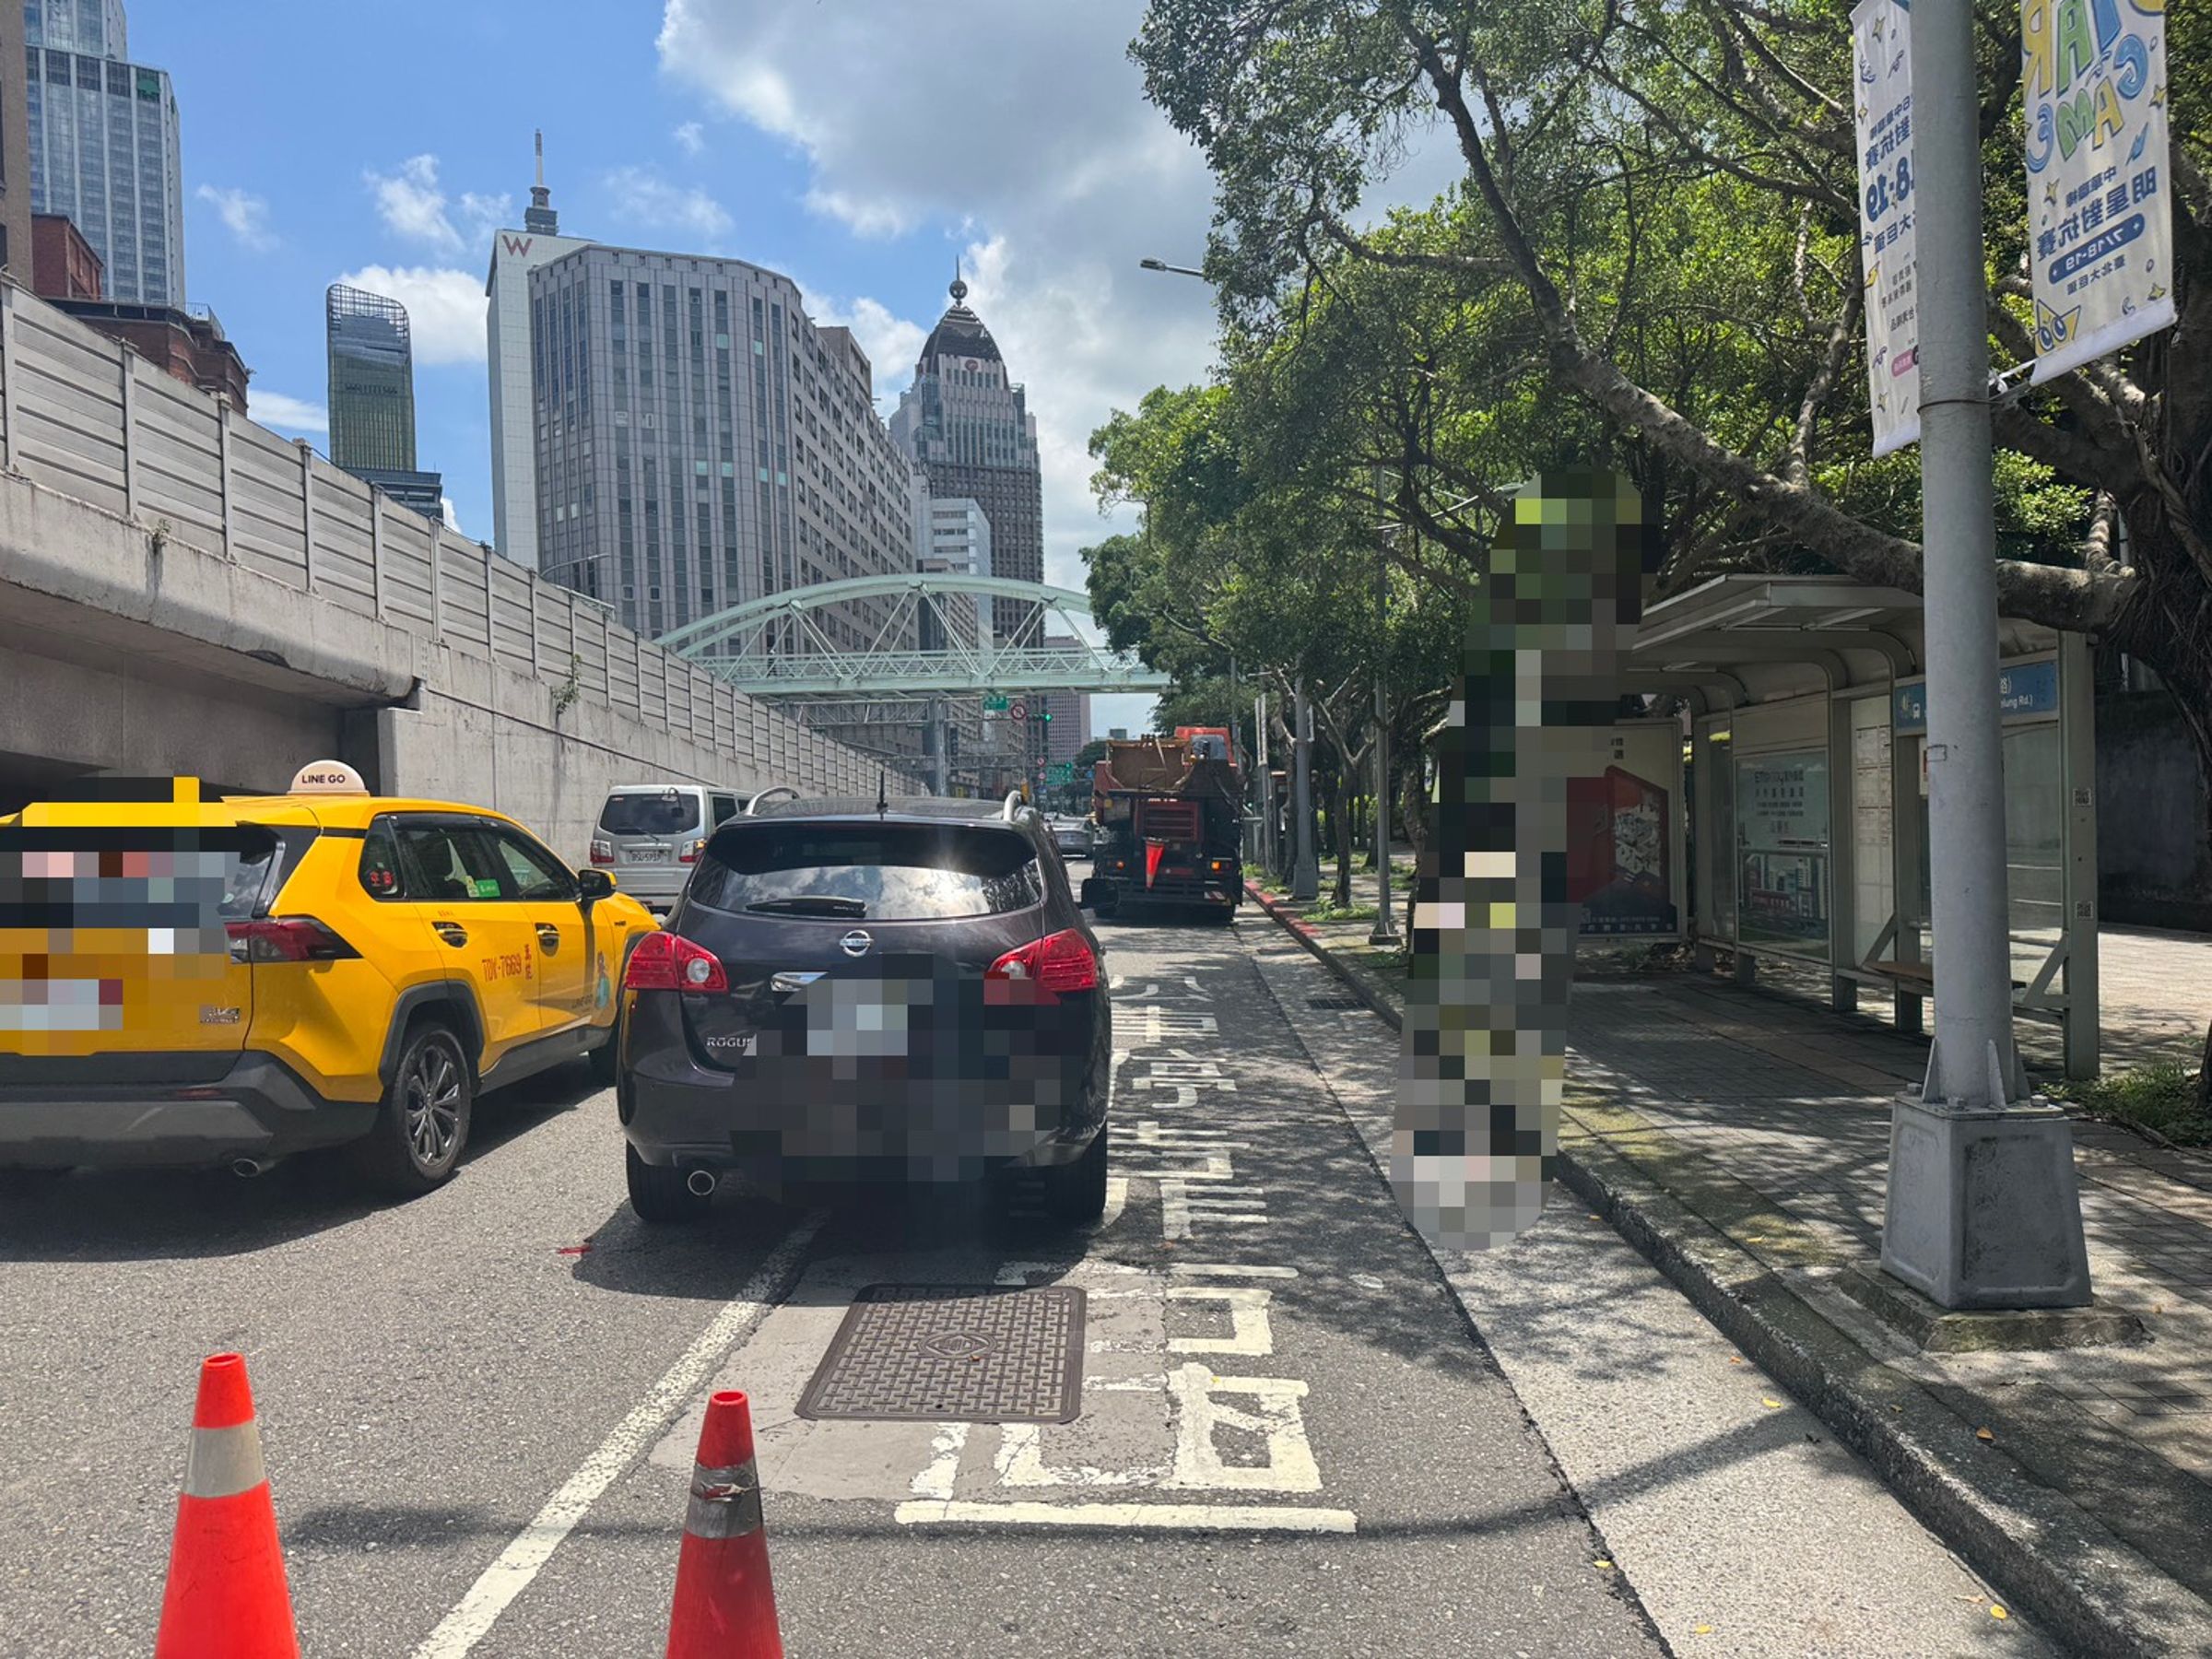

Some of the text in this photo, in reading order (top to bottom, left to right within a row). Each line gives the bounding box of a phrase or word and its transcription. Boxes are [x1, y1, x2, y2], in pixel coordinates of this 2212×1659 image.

[501, 234, 533, 258] W
[301, 773, 346, 784] LINE GO
